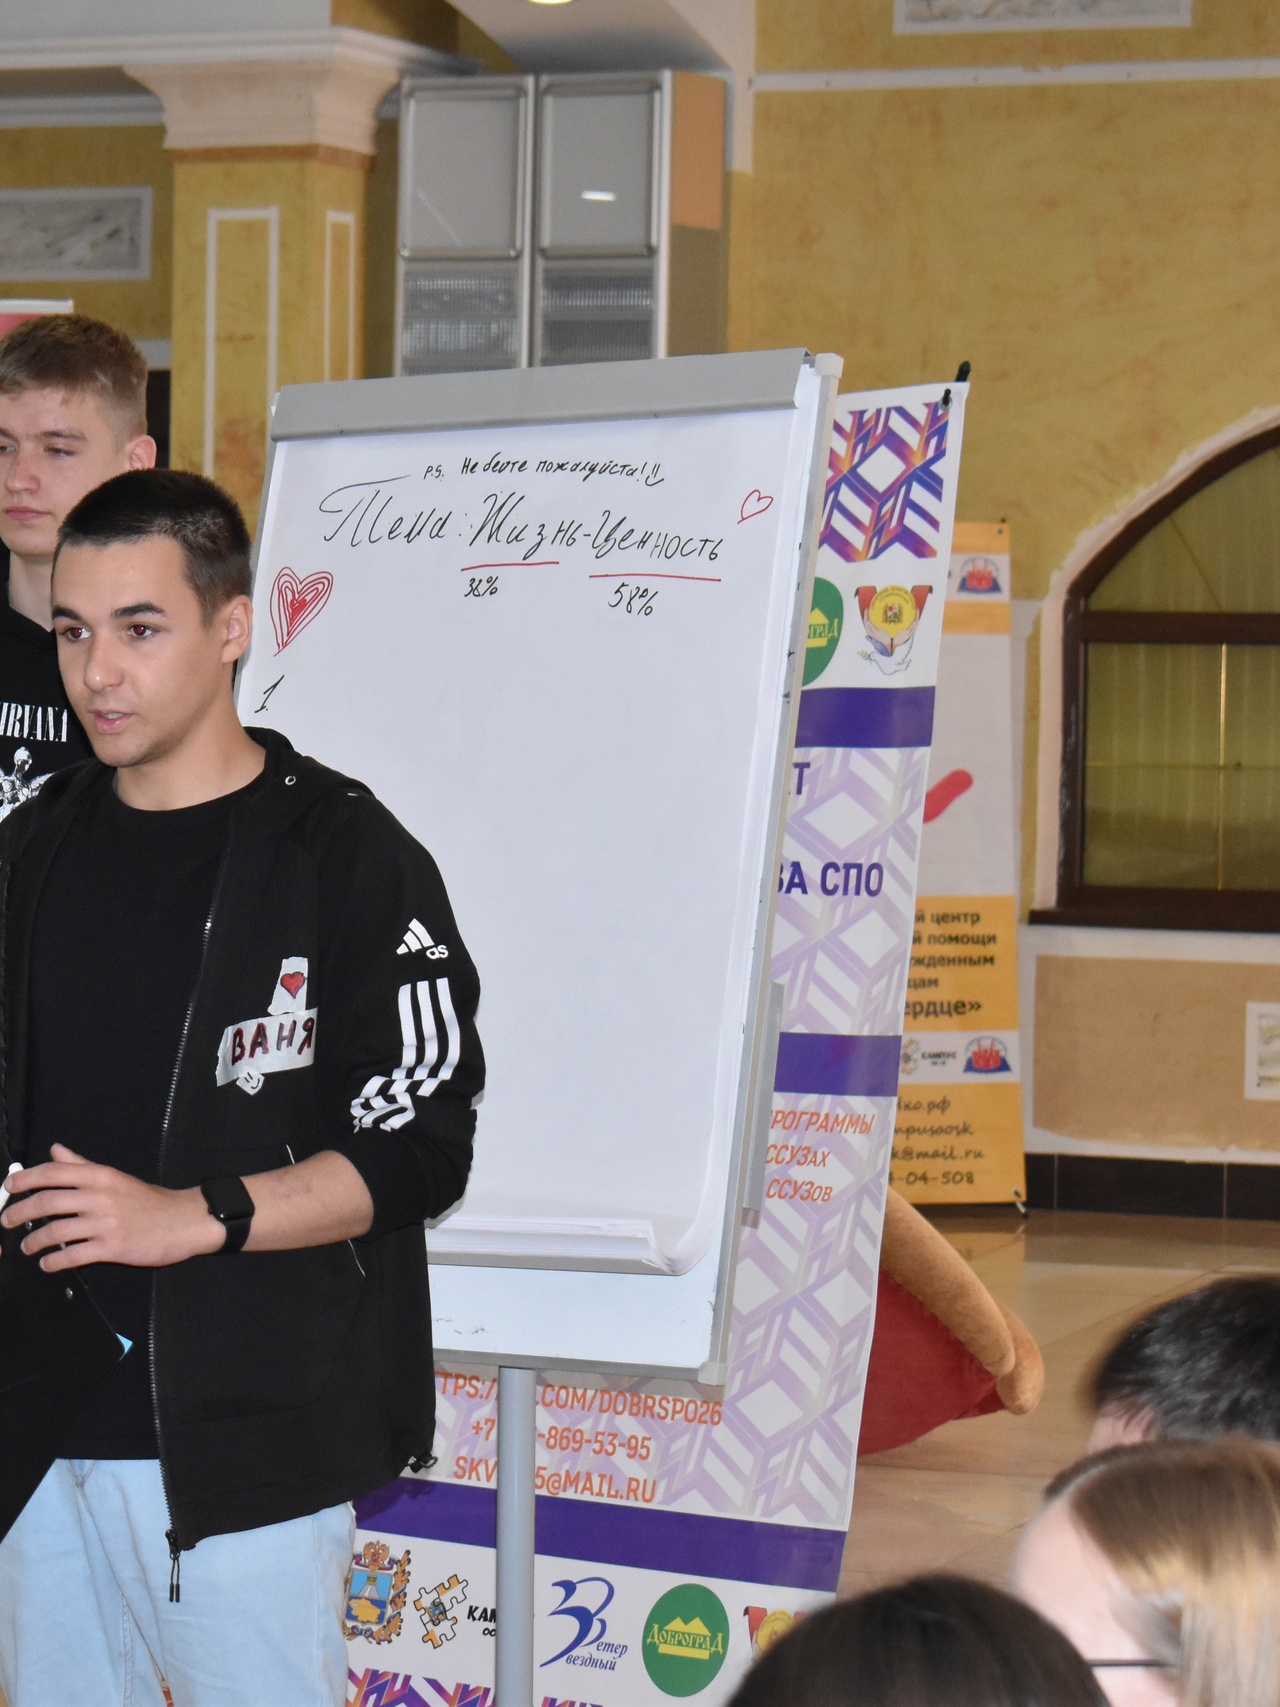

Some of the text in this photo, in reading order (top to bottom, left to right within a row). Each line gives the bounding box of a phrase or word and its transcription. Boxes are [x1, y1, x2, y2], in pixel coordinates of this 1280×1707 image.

[461, 457, 478, 475] Не
[608, 582, 660, 616] 58%
[820, 861, 884, 897] СПО
[930, 912, 981, 926] центр
[927, 933, 997, 946] помощи
[910, 955, 995, 968] жденным
[231, 1016, 315, 1066] ВАНЯ
[770, 1109, 875, 1134] РОГРАММЫ
